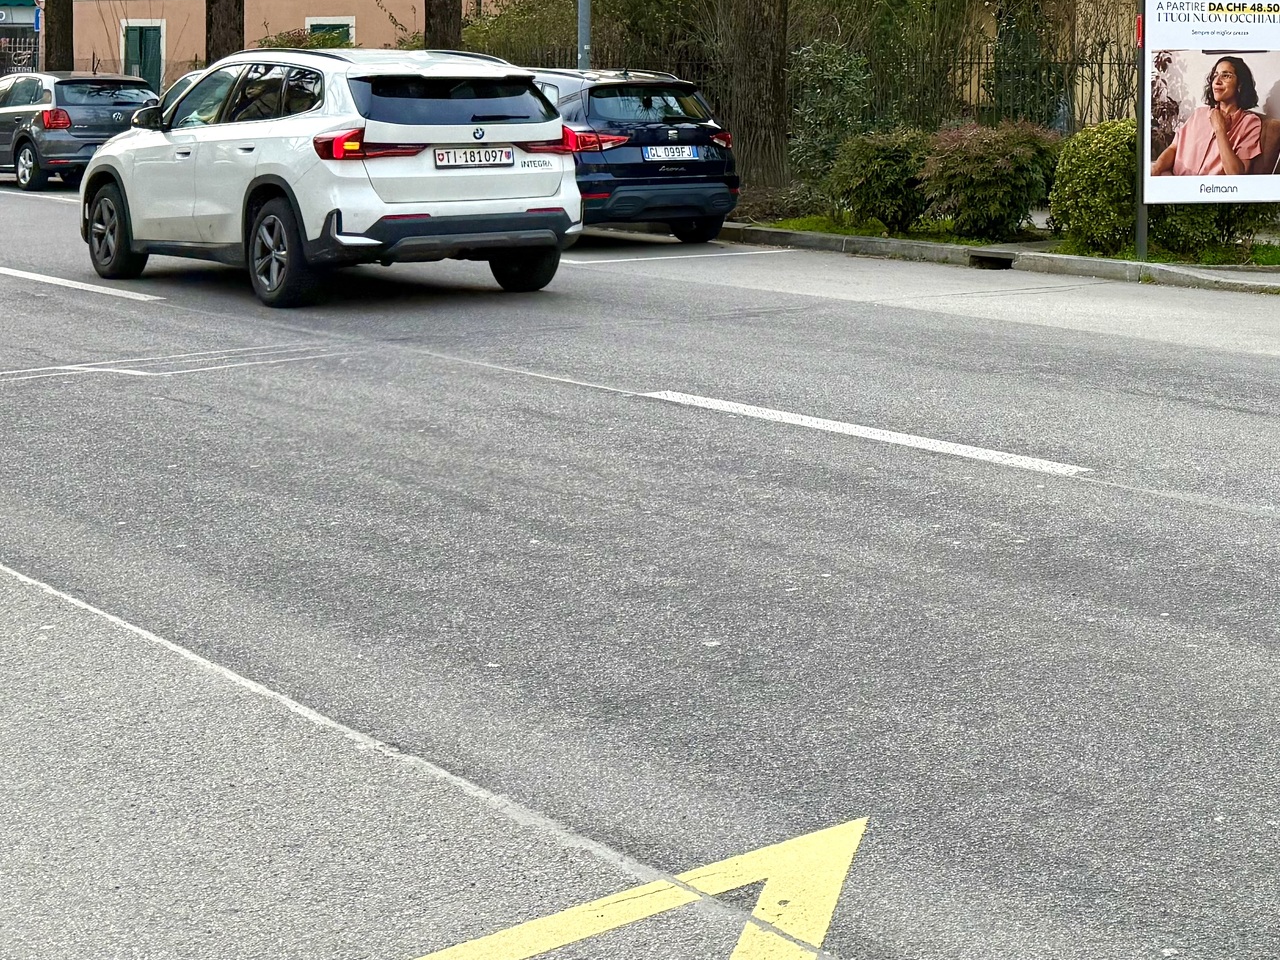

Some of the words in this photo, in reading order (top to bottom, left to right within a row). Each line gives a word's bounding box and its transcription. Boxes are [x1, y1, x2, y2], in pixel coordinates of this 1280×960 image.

[1156, 1, 1164, 11] A
[1166, 1, 1206, 12] PARTIRE
[1208, 2, 1225, 12] DA
[1226, 2, 1248, 13] CHF
[1163, 12, 1190, 23] TUOI
[1193, 13, 1227, 23] NUOVI
[520, 159, 553, 168] INTEGRA
